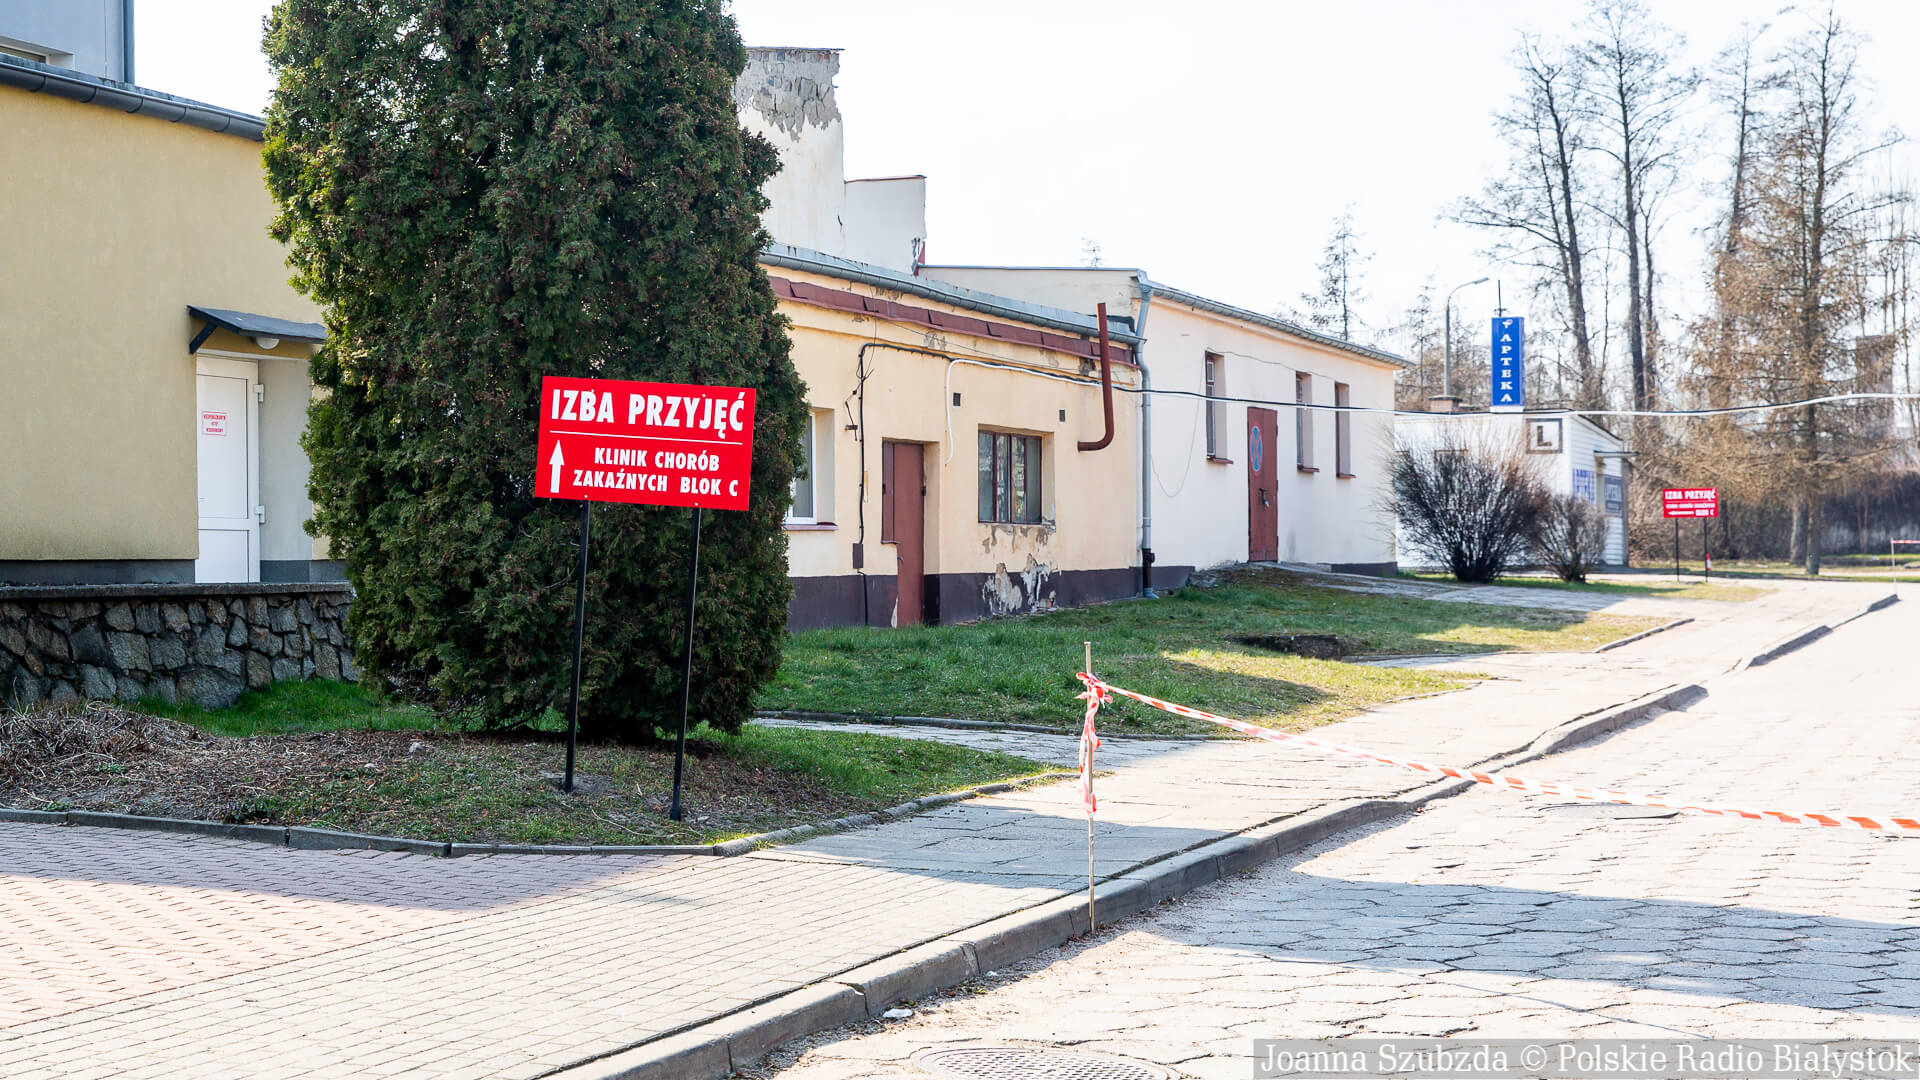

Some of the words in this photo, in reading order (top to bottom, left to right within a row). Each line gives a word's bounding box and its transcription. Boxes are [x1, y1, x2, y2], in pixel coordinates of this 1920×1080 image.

[1500, 333, 1513, 402] APTEKA
[551, 388, 615, 424] IZBA
[628, 392, 746, 439] PRZYJĘĆ
[594, 447, 648, 467] KLINIK
[654, 450, 720, 472] CHORÓB
[572, 468, 668, 492] ZAKAŹNYCH
[680, 476, 722, 496] BLOK
[728, 480, 739, 496] C
